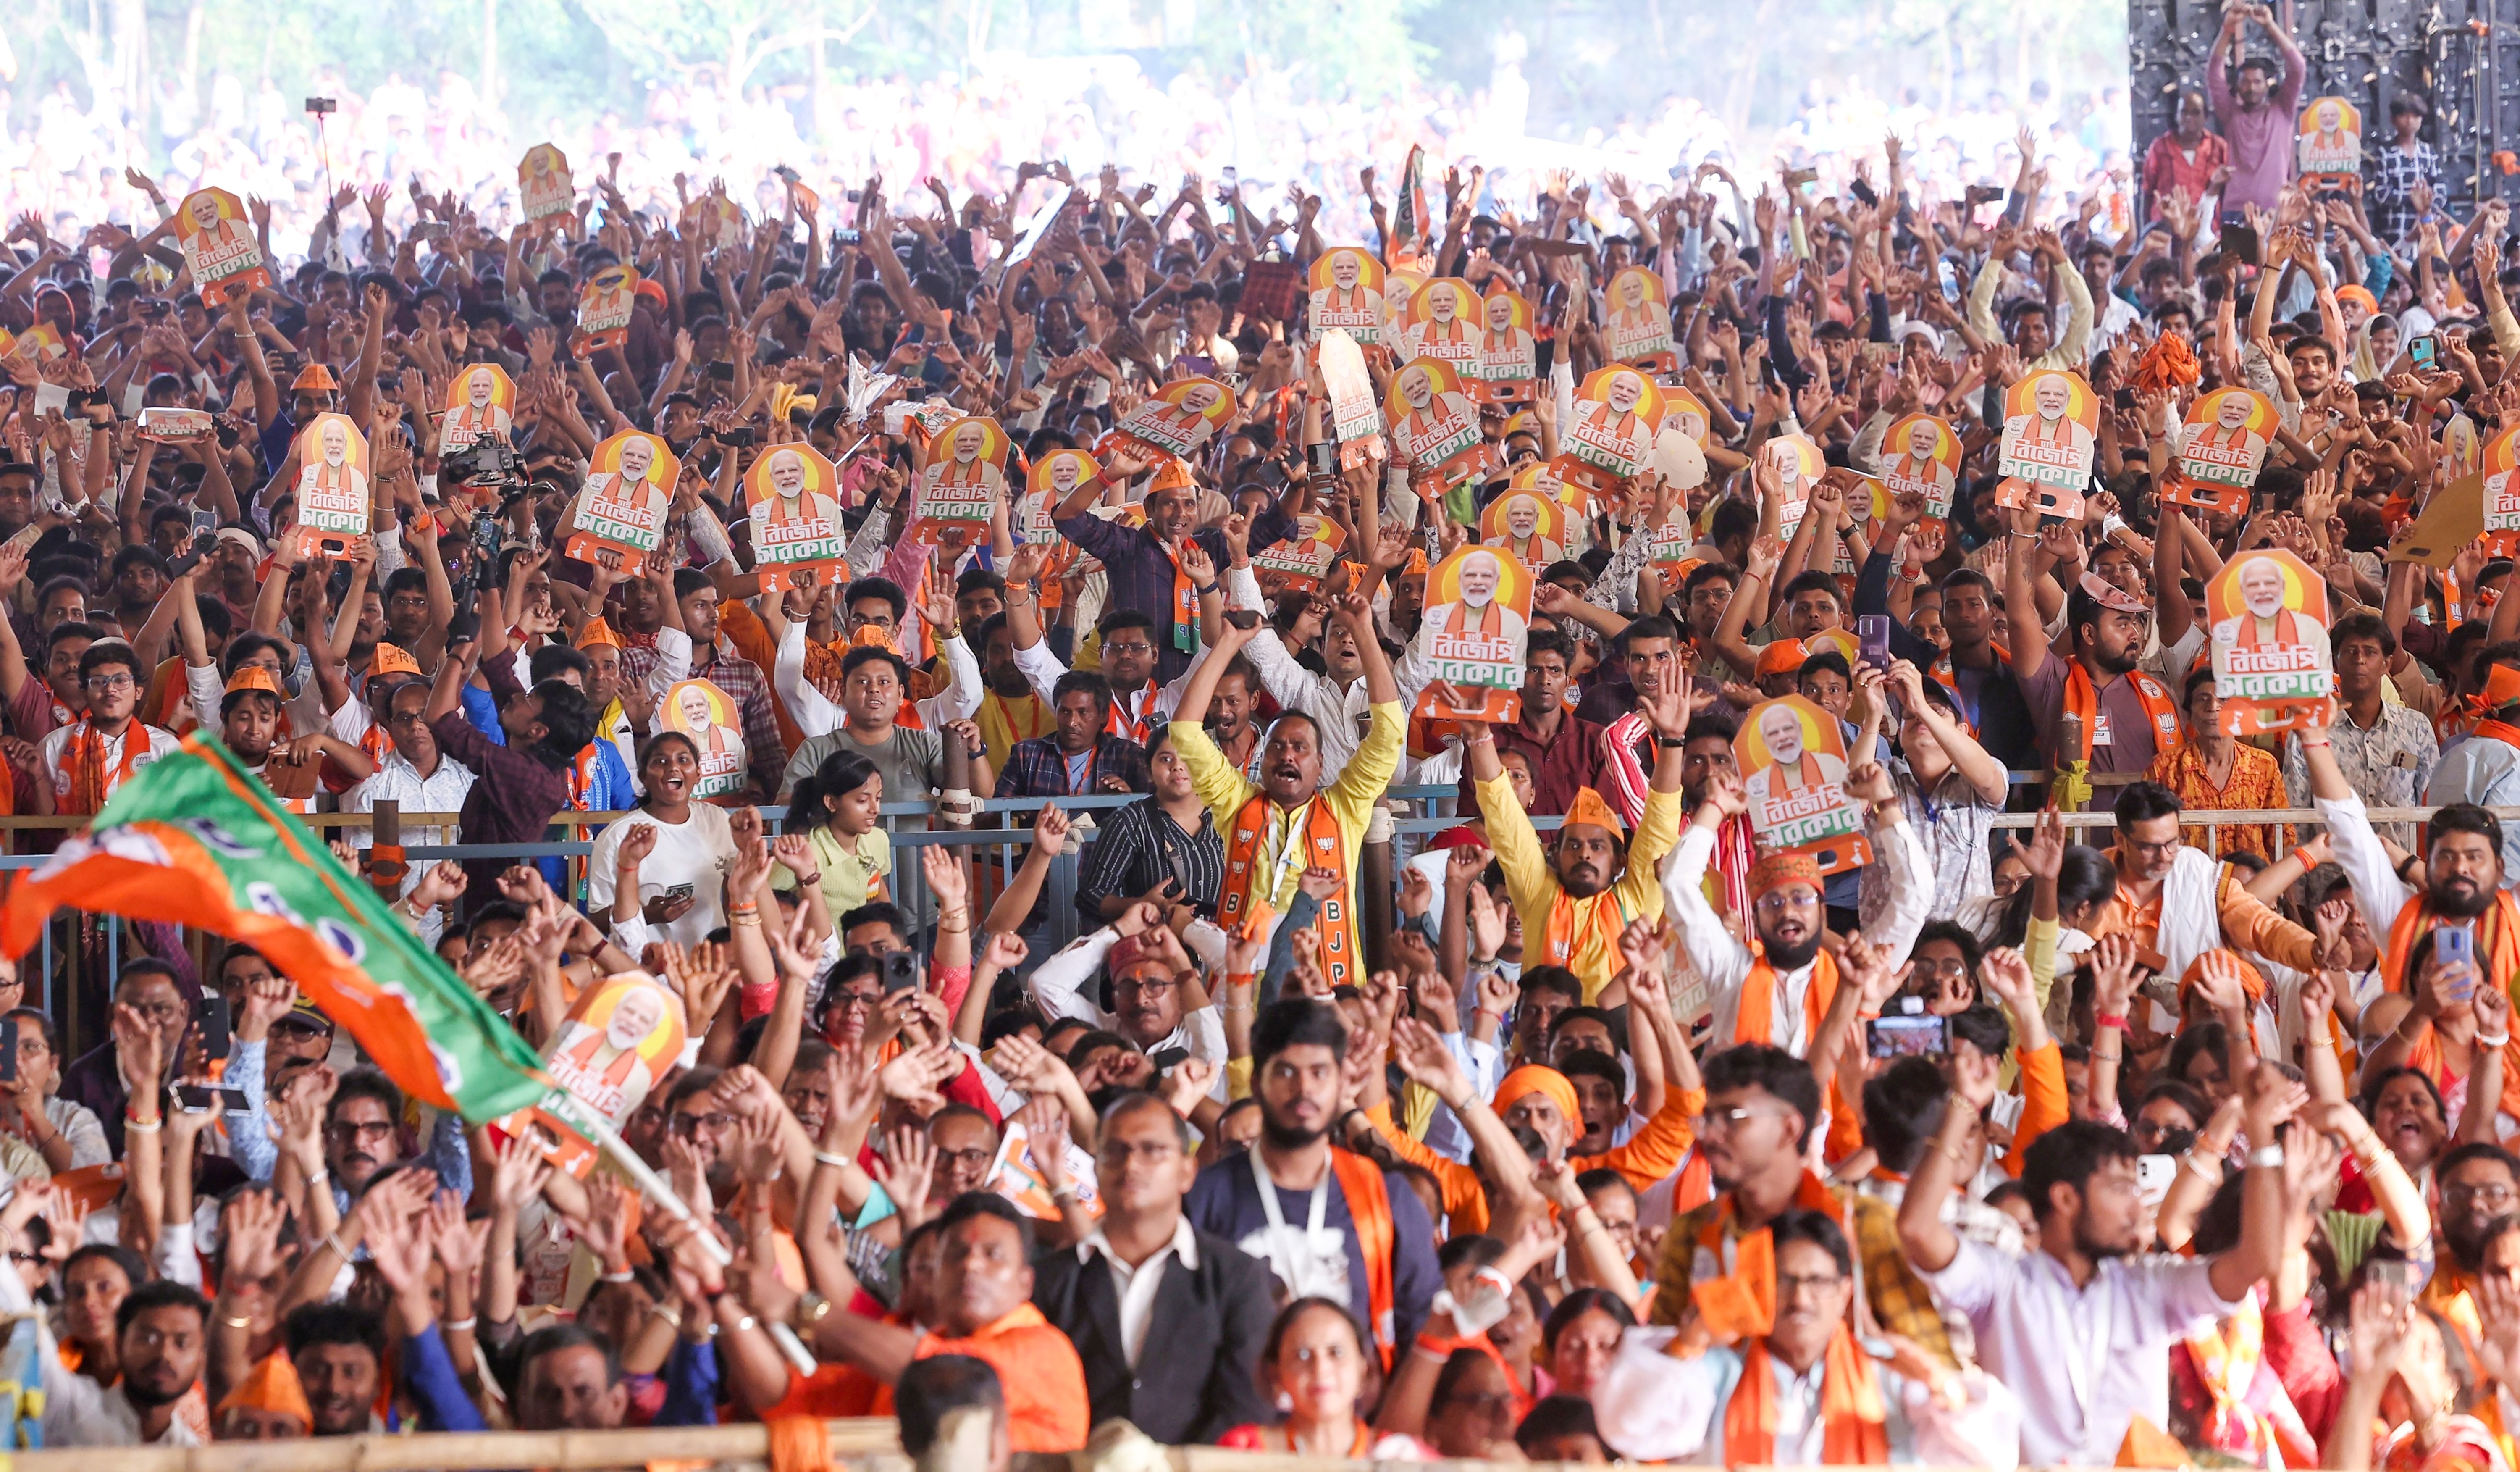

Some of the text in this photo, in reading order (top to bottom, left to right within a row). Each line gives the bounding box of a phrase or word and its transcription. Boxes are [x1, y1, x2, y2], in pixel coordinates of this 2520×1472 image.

[1317, 309, 1378, 326] বিজেপি
[1415, 342, 1476, 358] বিজেপি
[1409, 410, 1469, 456] বিজেপি
[1572, 419, 1642, 461] বিজেপি
[1560, 433, 1644, 476] সরকার
[2009, 437, 2085, 467] বিজেপি
[2184, 441, 2256, 467] বিজেপি
[1998, 457, 2092, 491] সরকার
[308, 487, 363, 512] বিজেপি
[926, 484, 992, 500] বিজেপি
[299, 507, 368, 534] সরকার
[587, 494, 659, 529] বিজেপি
[916, 502, 997, 521] সরকার
[573, 511, 662, 551] সরকার
[759, 518, 834, 544] বিজেপি
[755, 536, 846, 564] সরকার
[1430, 632, 1517, 662] বিজেপি
[2225, 646, 2320, 672] বিজেপি
[1420, 658, 1525, 689] সরকার
[2216, 673, 2333, 700] সরকার
[693, 771, 747, 800] রকার
[1761, 784, 1846, 825] বিজেপি
[1325, 900, 1345, 984] BJP
